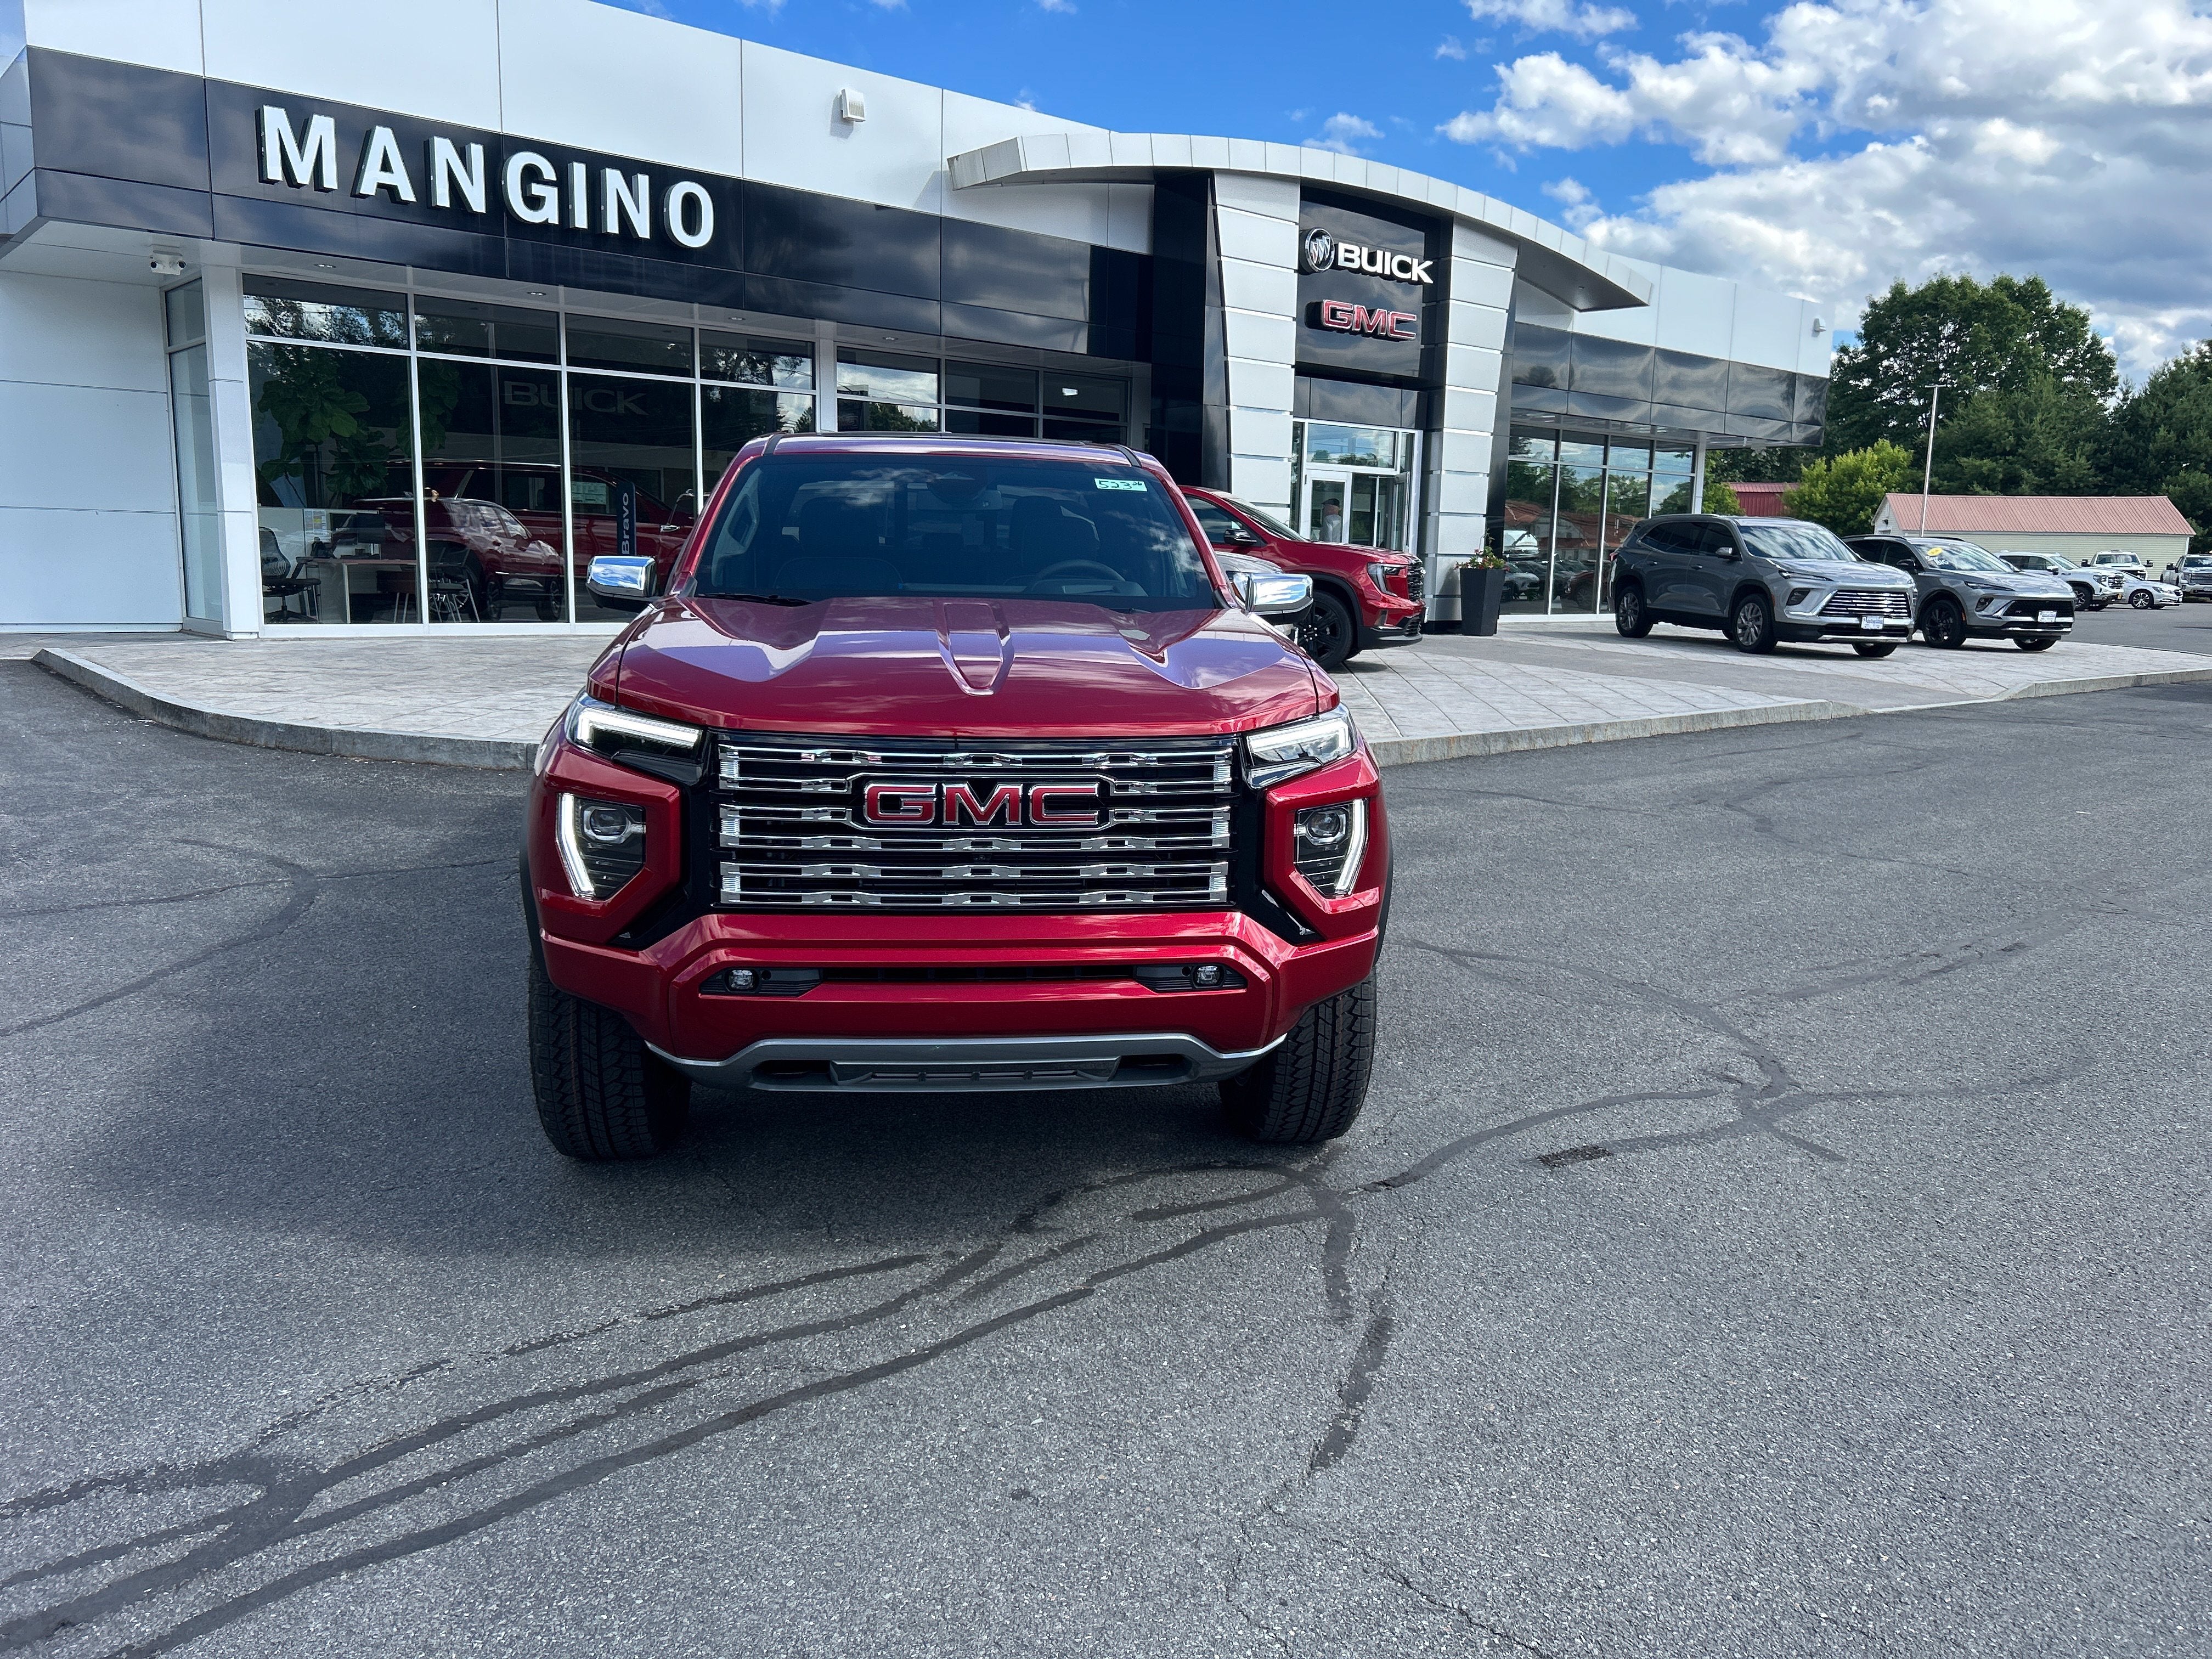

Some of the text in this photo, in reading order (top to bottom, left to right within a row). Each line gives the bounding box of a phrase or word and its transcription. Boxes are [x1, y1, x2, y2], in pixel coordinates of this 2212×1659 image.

[260, 104, 715, 249] MANGINO
[1337, 241, 1434, 284] BUICK
[1322, 299, 1417, 340] GMC
[504, 381, 650, 415] BUICK
[622, 492, 630, 555] Bravo
[863, 782, 1099, 826] GMC
